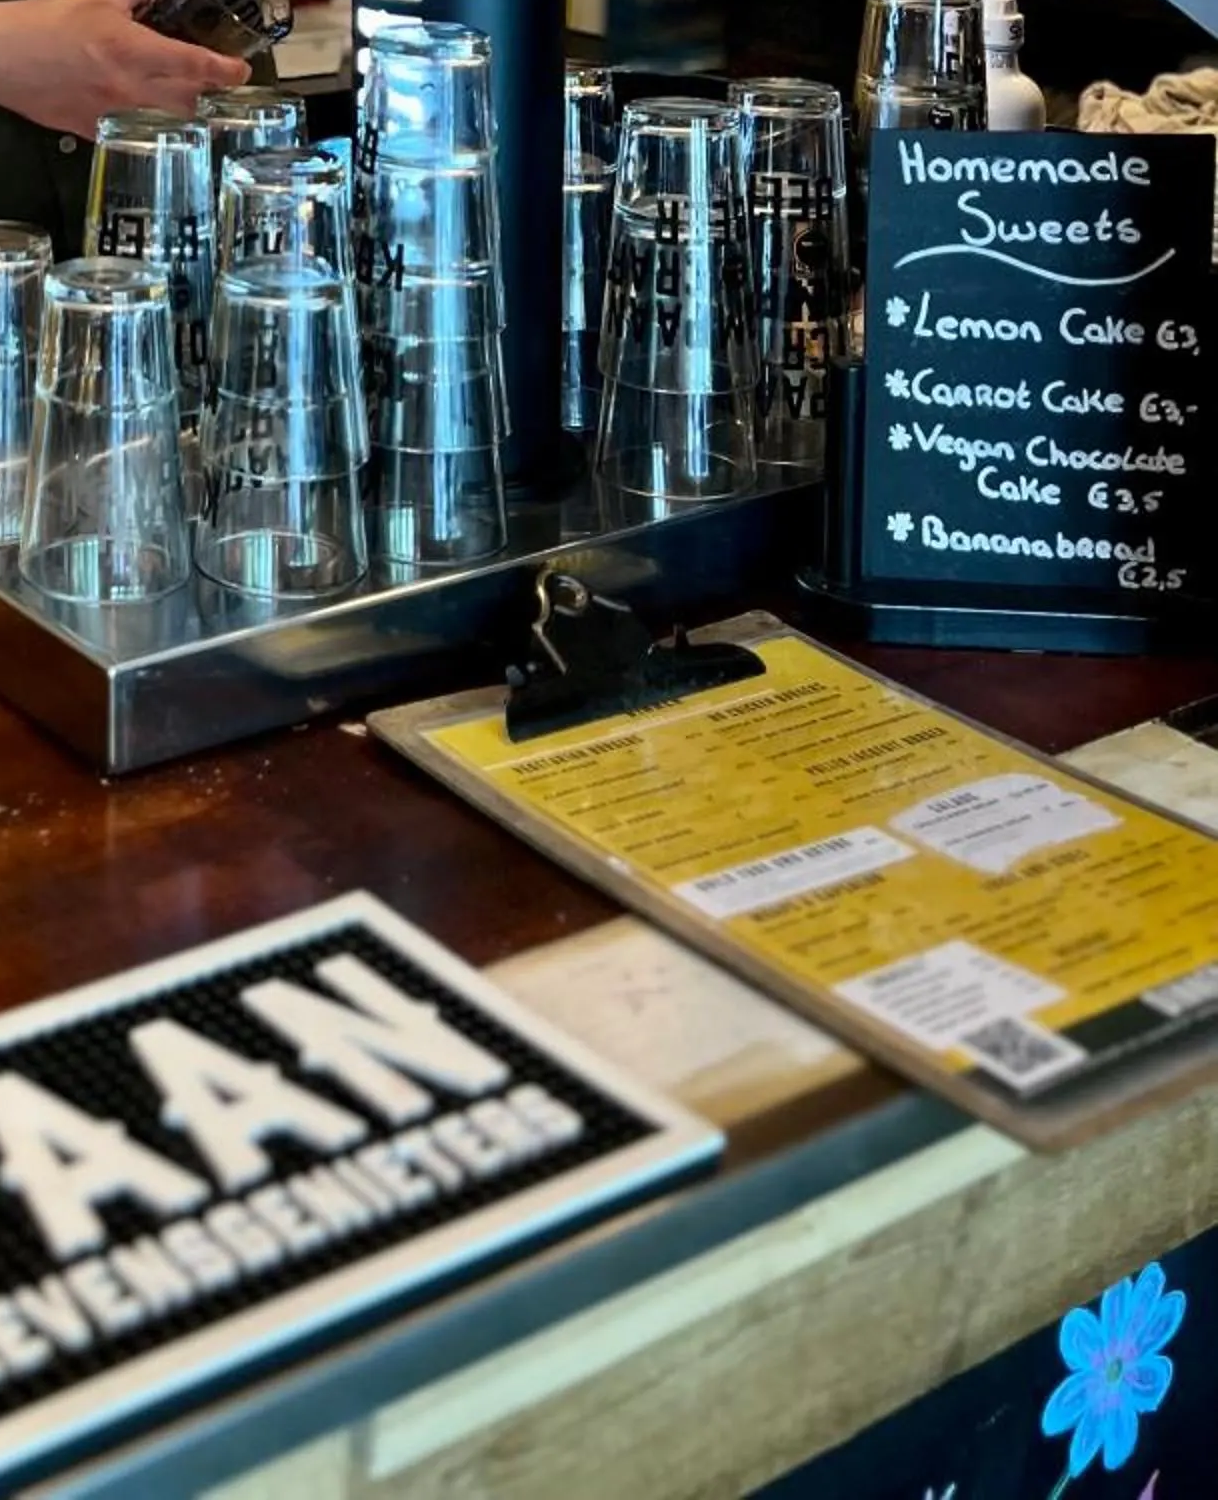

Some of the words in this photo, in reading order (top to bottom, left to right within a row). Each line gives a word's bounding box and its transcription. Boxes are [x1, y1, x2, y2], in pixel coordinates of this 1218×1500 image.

[898, 138, 1151, 185] Homemade
[957, 190, 1142, 246] Sweets
[913, 291, 1042, 343] Lemon
[1059, 307, 1145, 345] Cake
[1042, 380, 1125, 414] Cake
[912, 422, 1015, 472] Vegan
[1025, 436, 1186, 475] Chocolate
[977, 466, 1061, 506] Cake
